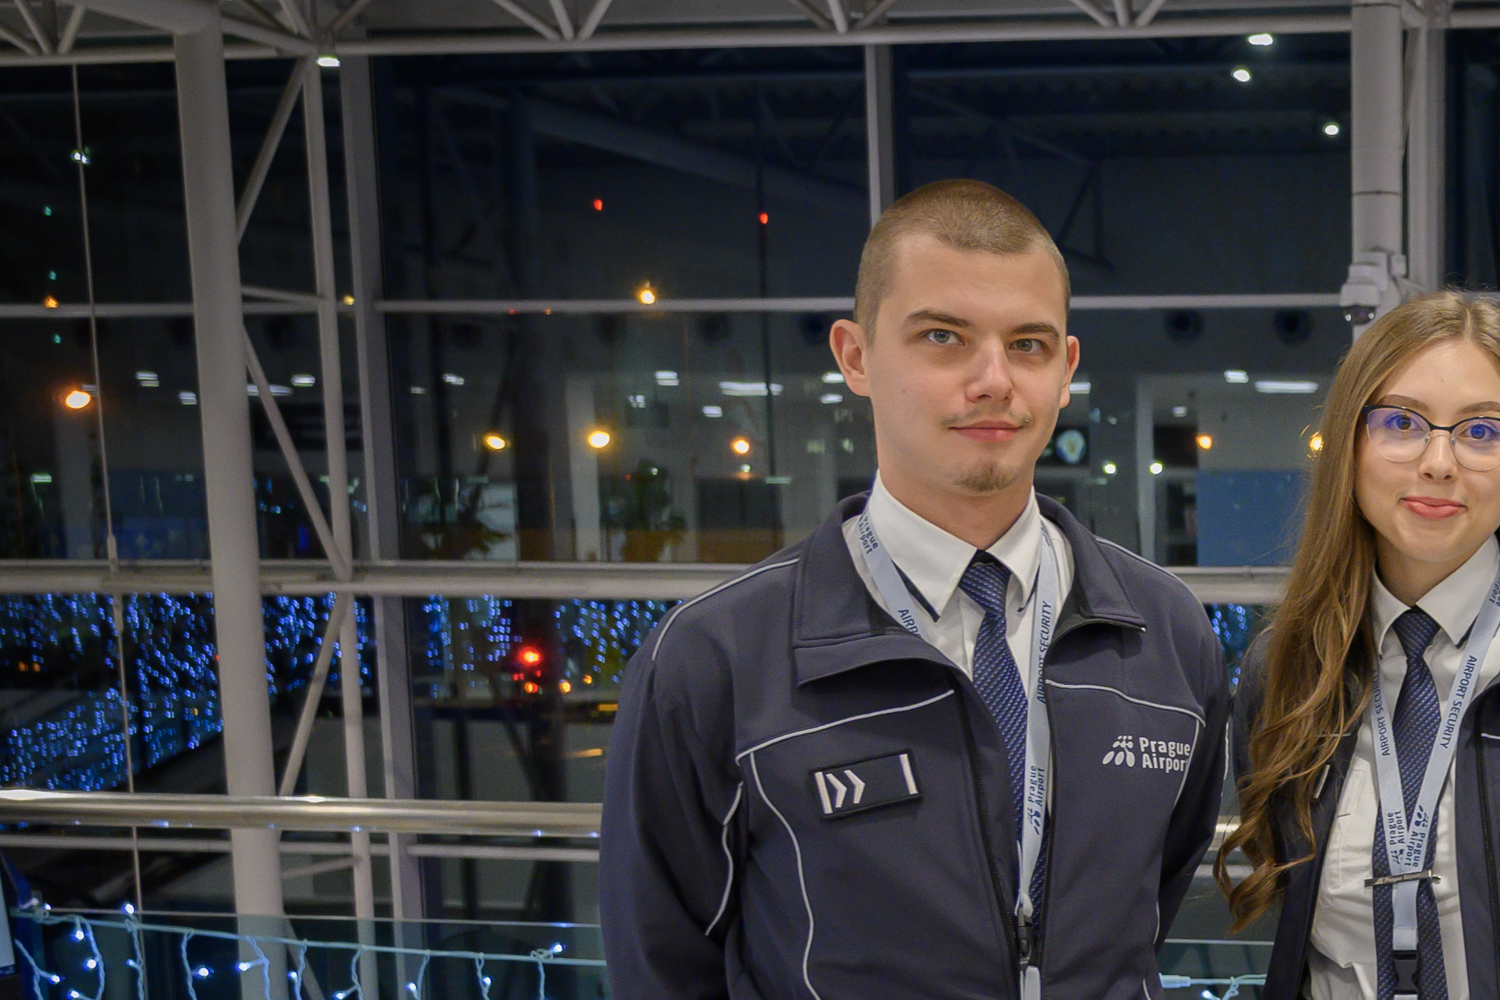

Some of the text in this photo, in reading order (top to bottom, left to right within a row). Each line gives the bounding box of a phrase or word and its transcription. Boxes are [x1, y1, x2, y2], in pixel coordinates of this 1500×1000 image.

[1440, 654, 1478, 750] AIRPORT SECURITY
[1139, 737, 1191, 758] Prague
[1376, 716, 1391, 757] AIRPORT
[1142, 753, 1189, 774] Airpor
[1027, 765, 1037, 804] Prague
[1035, 767, 1046, 808] Airport
[1387, 811, 1397, 846] Prague
[1394, 810, 1406, 844] Airport
[1404, 830, 1419, 867] Airport
[1412, 832, 1427, 868] Prague
